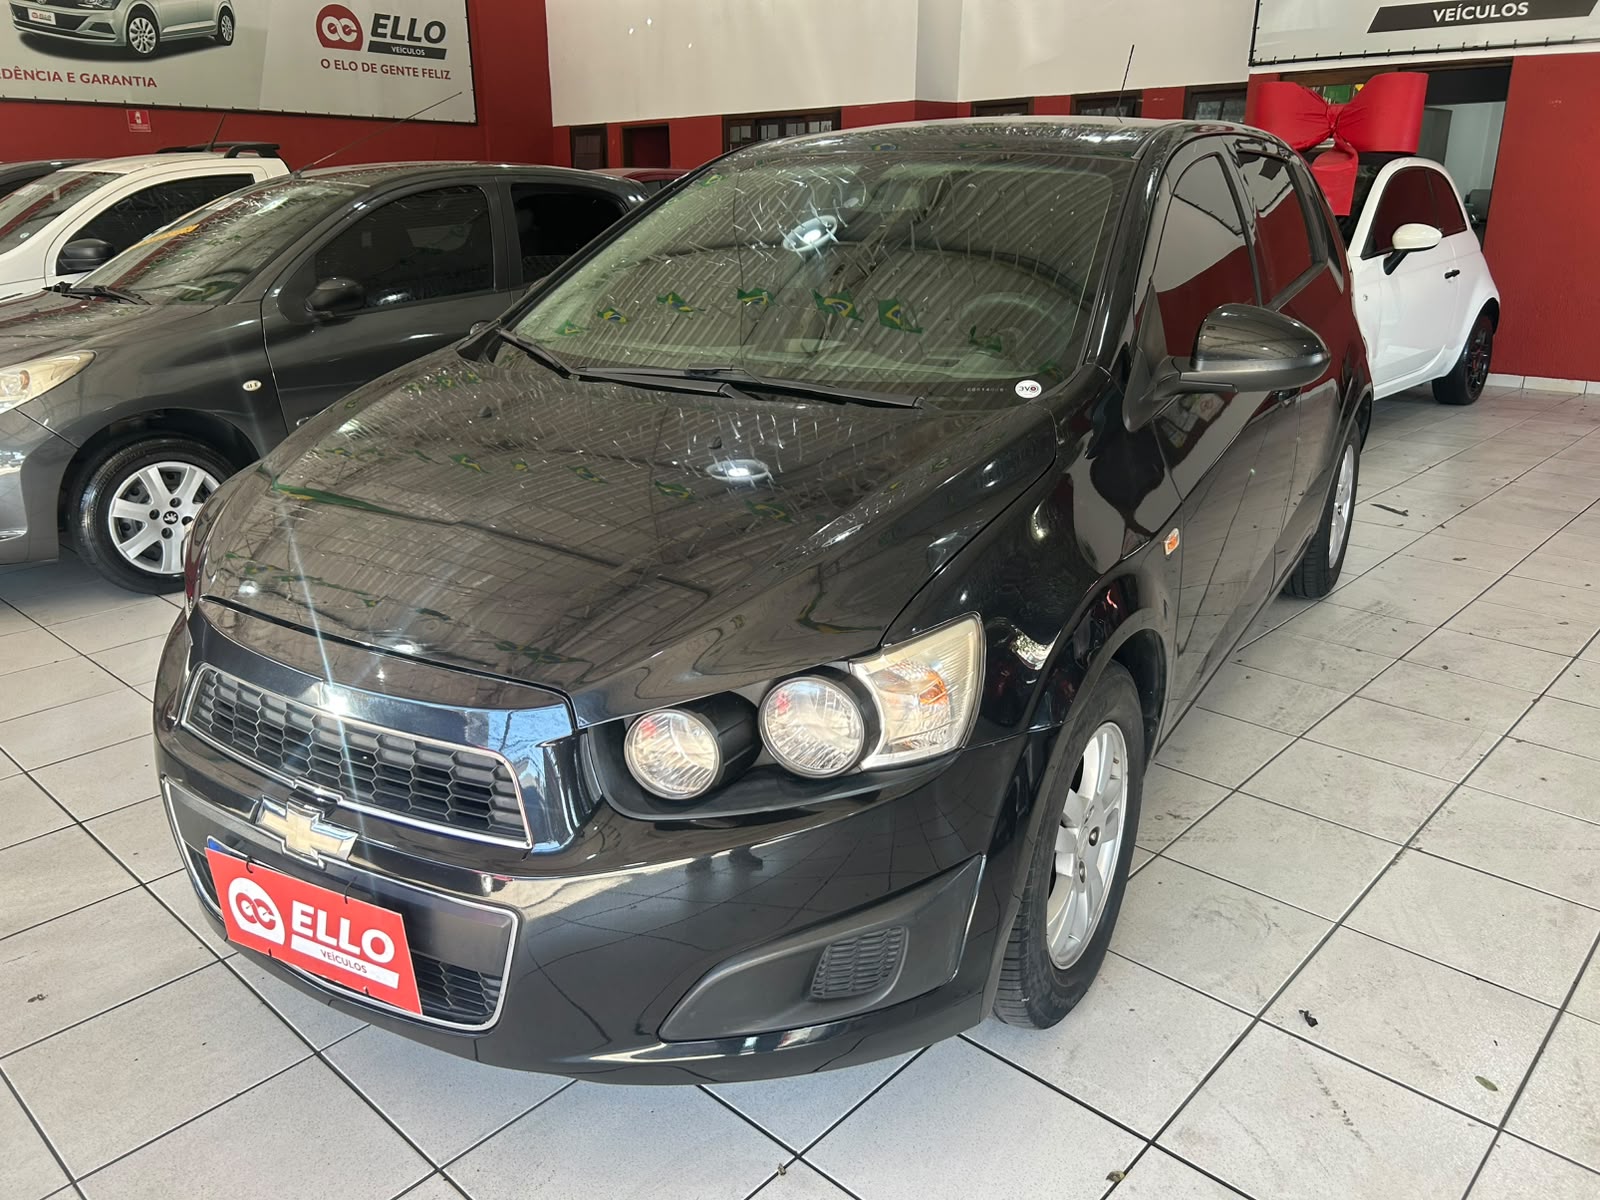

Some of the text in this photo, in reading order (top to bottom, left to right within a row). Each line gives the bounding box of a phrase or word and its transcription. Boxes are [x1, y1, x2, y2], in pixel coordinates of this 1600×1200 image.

[1432, 2, 1529, 22] VEÍCULOS
[370, 13, 446, 44] ELLO
[391, 46, 426, 56] VEÍCULOS
[0, 65, 158, 88] DÊNCIA E GARANTIA
[320, 58, 451, 80] O ELO DE GENTE FELIZ
[291, 900, 395, 964] ELLO
[320, 949, 368, 974] VEÍCULOS
